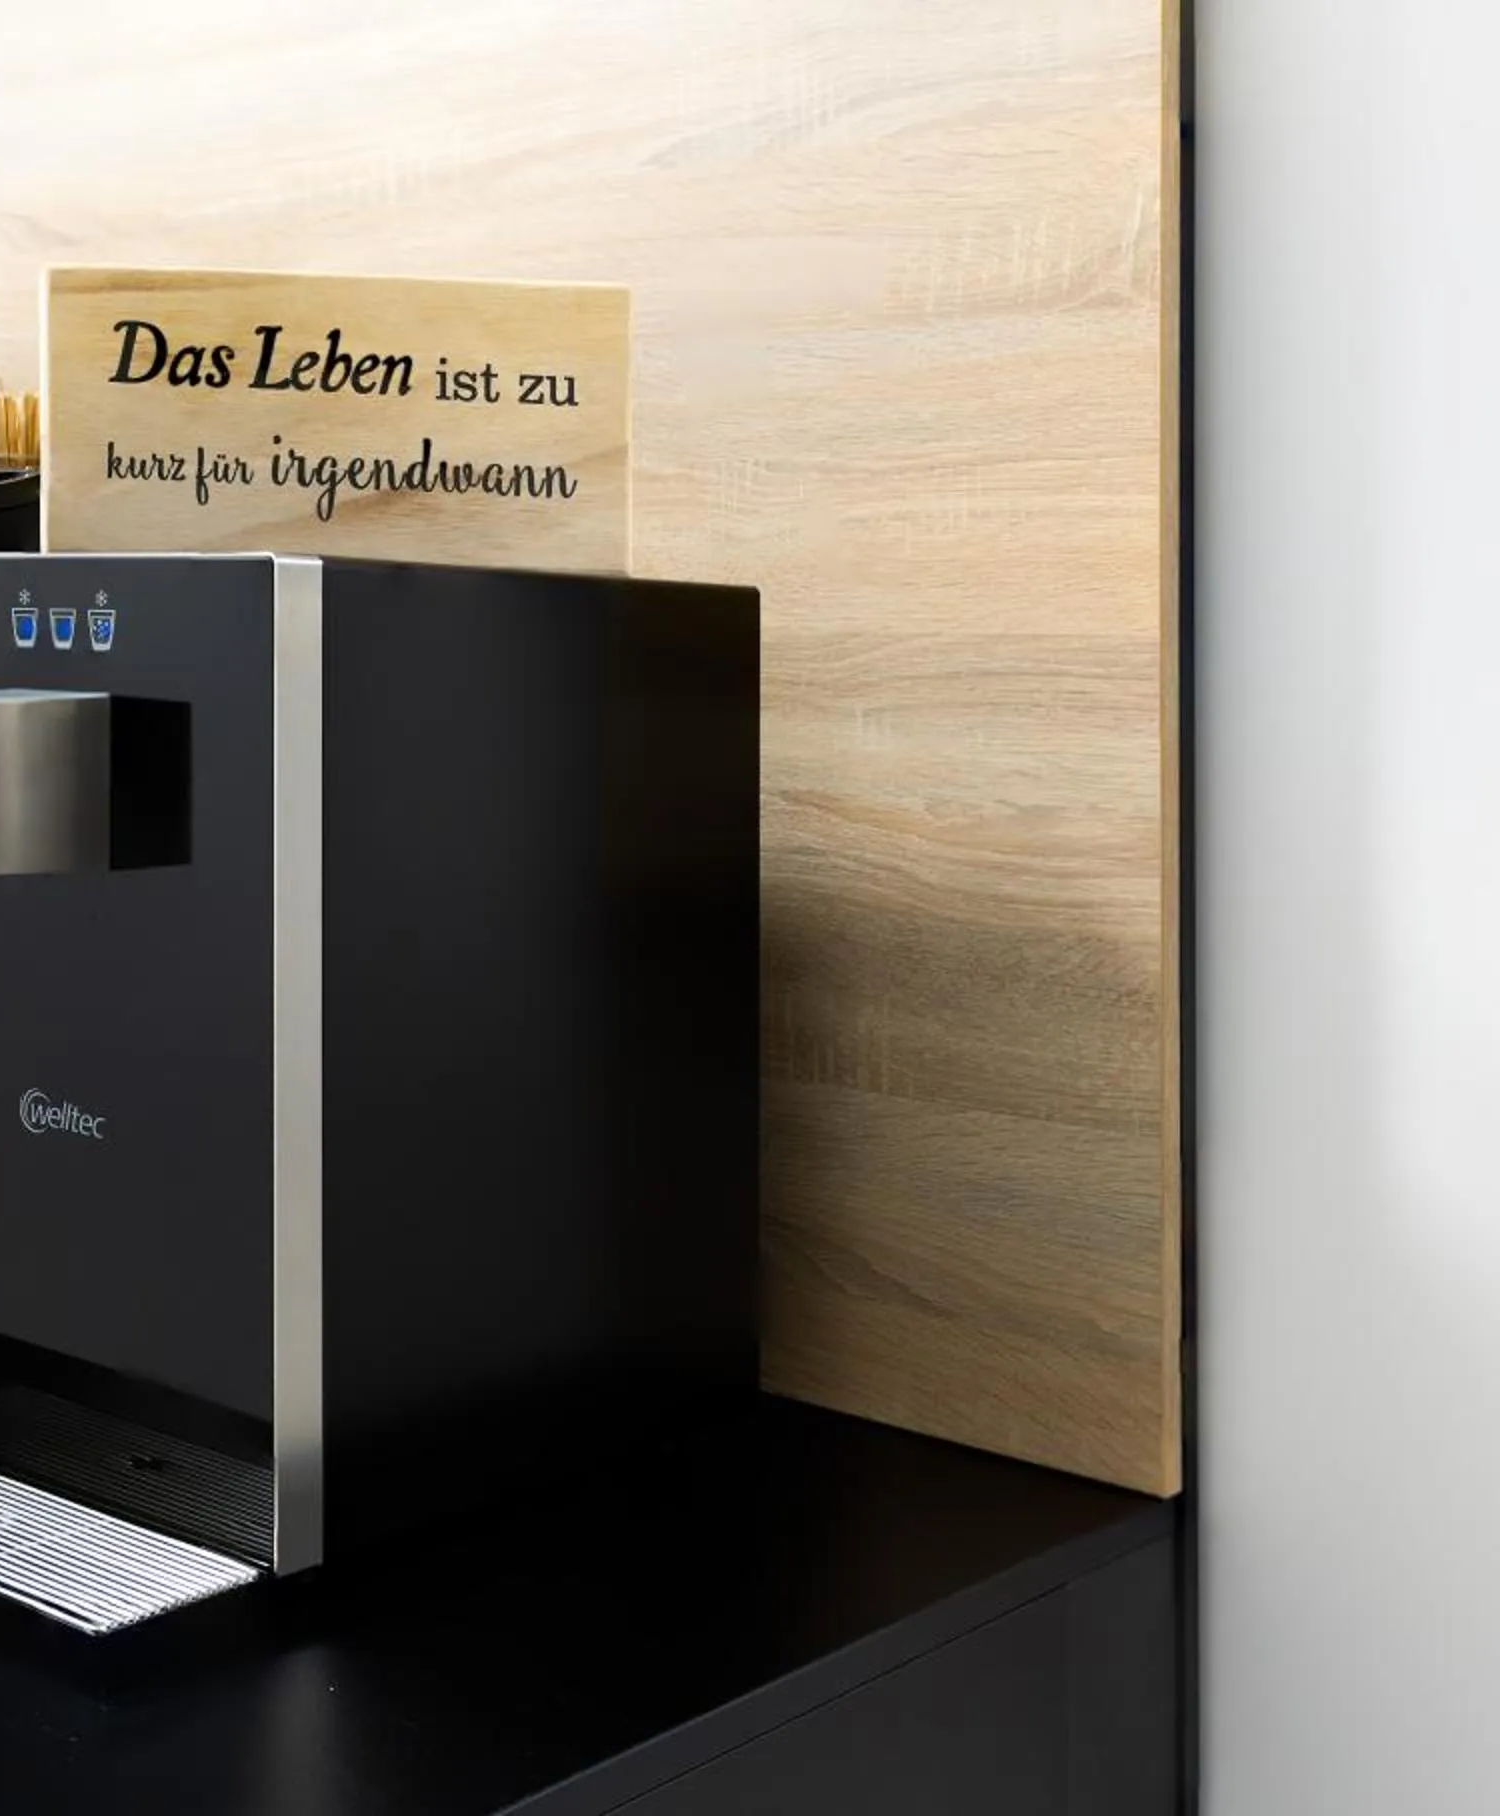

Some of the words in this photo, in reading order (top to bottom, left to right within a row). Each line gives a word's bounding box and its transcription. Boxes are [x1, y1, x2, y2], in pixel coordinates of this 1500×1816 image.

[108, 319, 235, 389] Das
[248, 325, 414, 397] Leben
[435, 357, 500, 403] ist
[517, 373, 580, 406] zu
[105, 441, 186, 481] kurz
[194, 446, 254, 505] für
[271, 435, 578, 521] irgendwann
[30, 1099, 107, 1139] welltec
